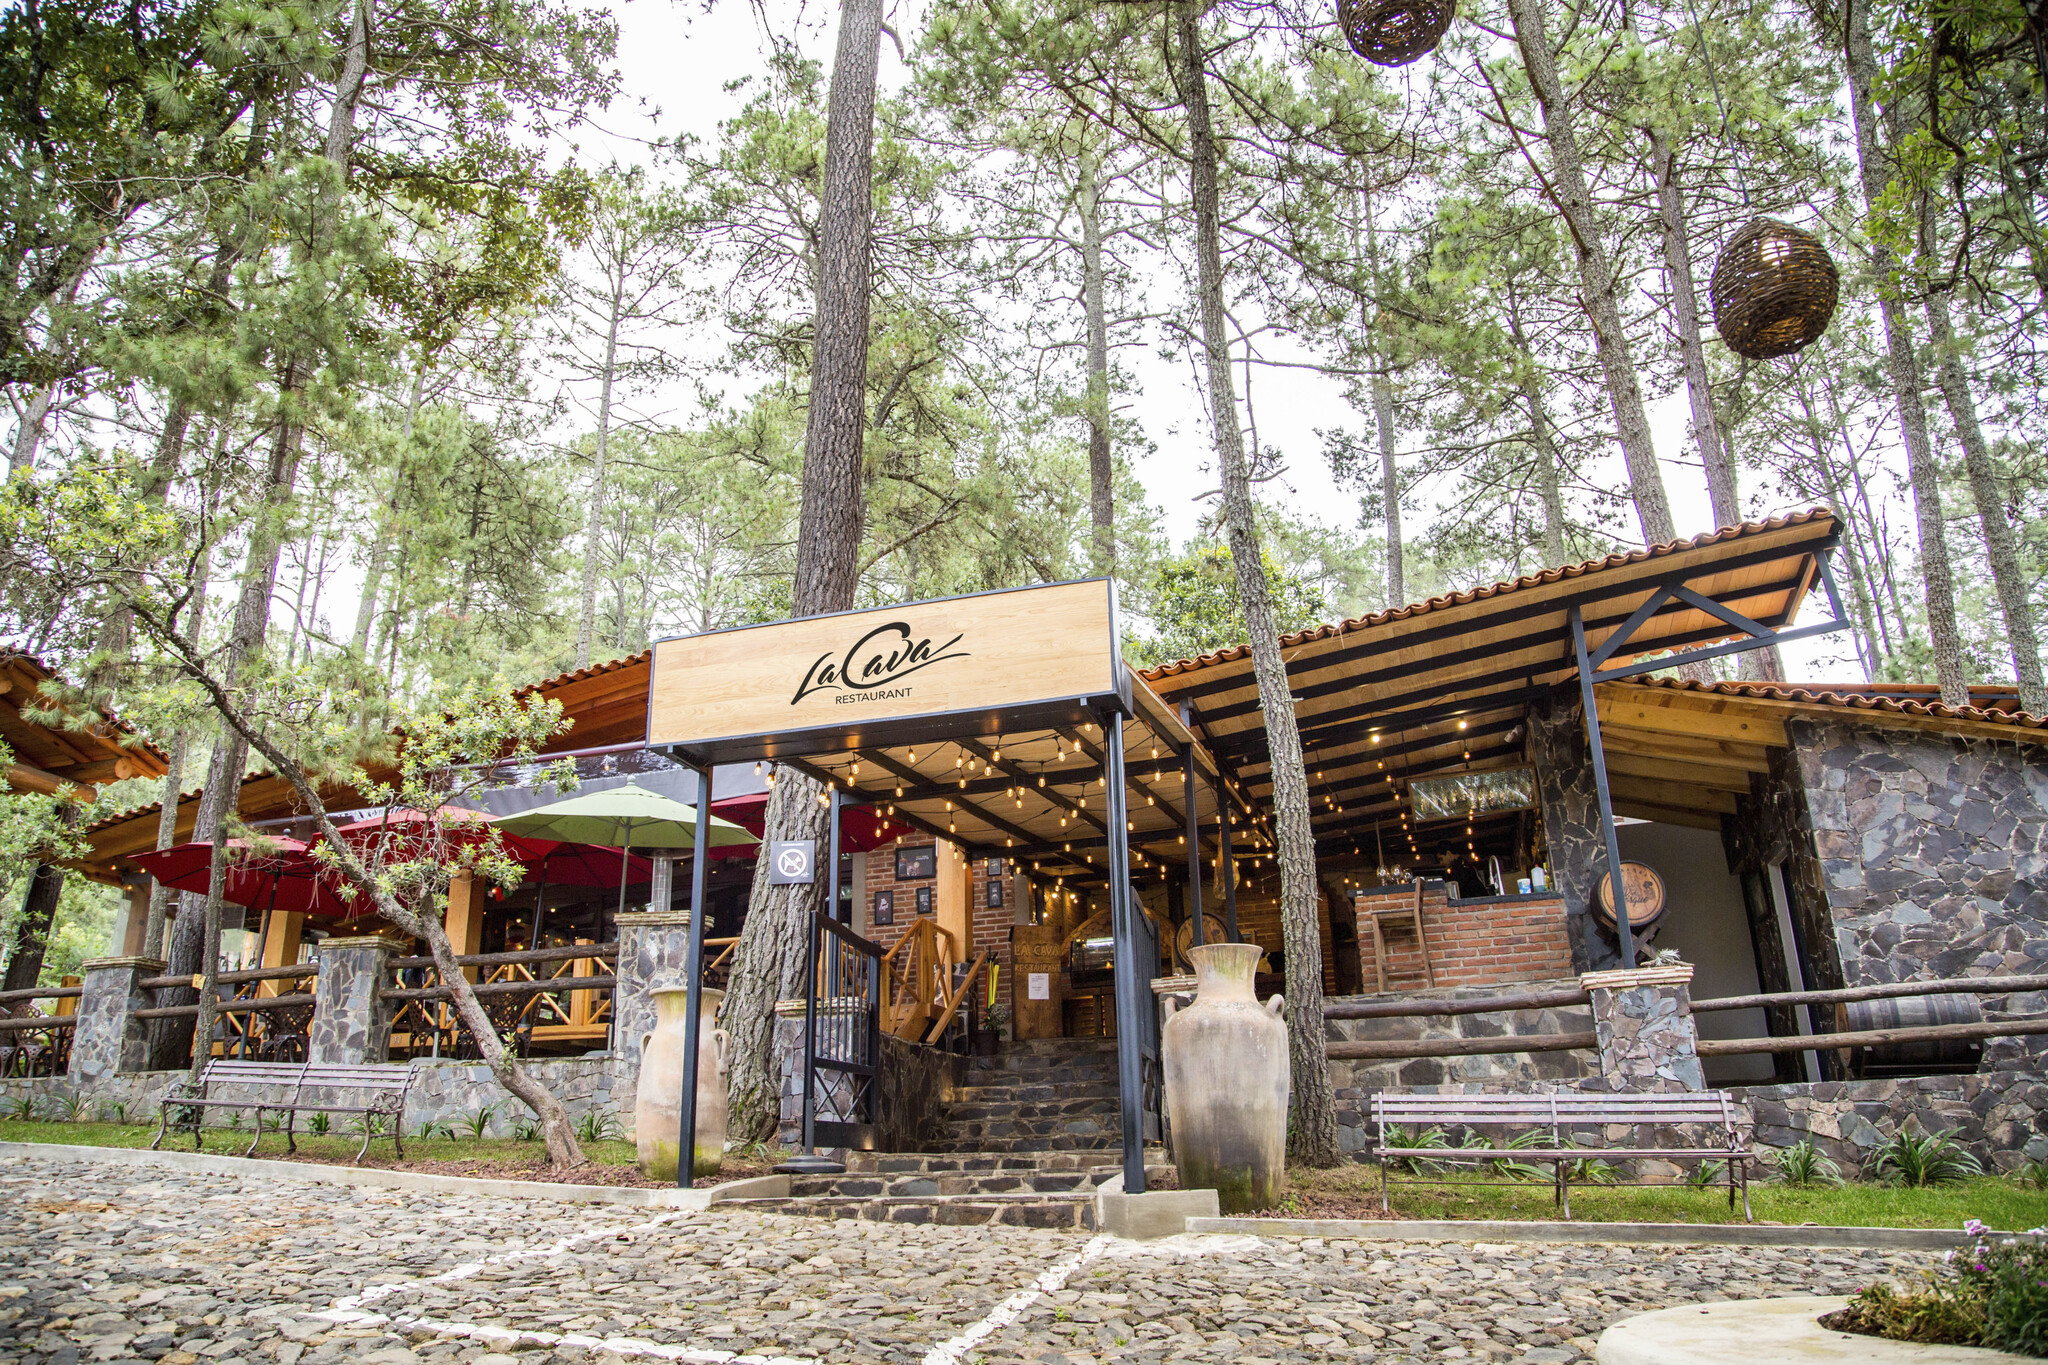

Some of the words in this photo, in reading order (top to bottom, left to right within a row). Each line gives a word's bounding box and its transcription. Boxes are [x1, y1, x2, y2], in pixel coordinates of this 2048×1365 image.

[791, 651, 843, 705] La
[841, 621, 972, 689] Cava
[835, 687, 913, 705] RESTAURANT
[1014, 943, 1031, 956] LA
[1033, 943, 1061, 957] CAVA
[1014, 963, 1062, 973] RESTAURANT
